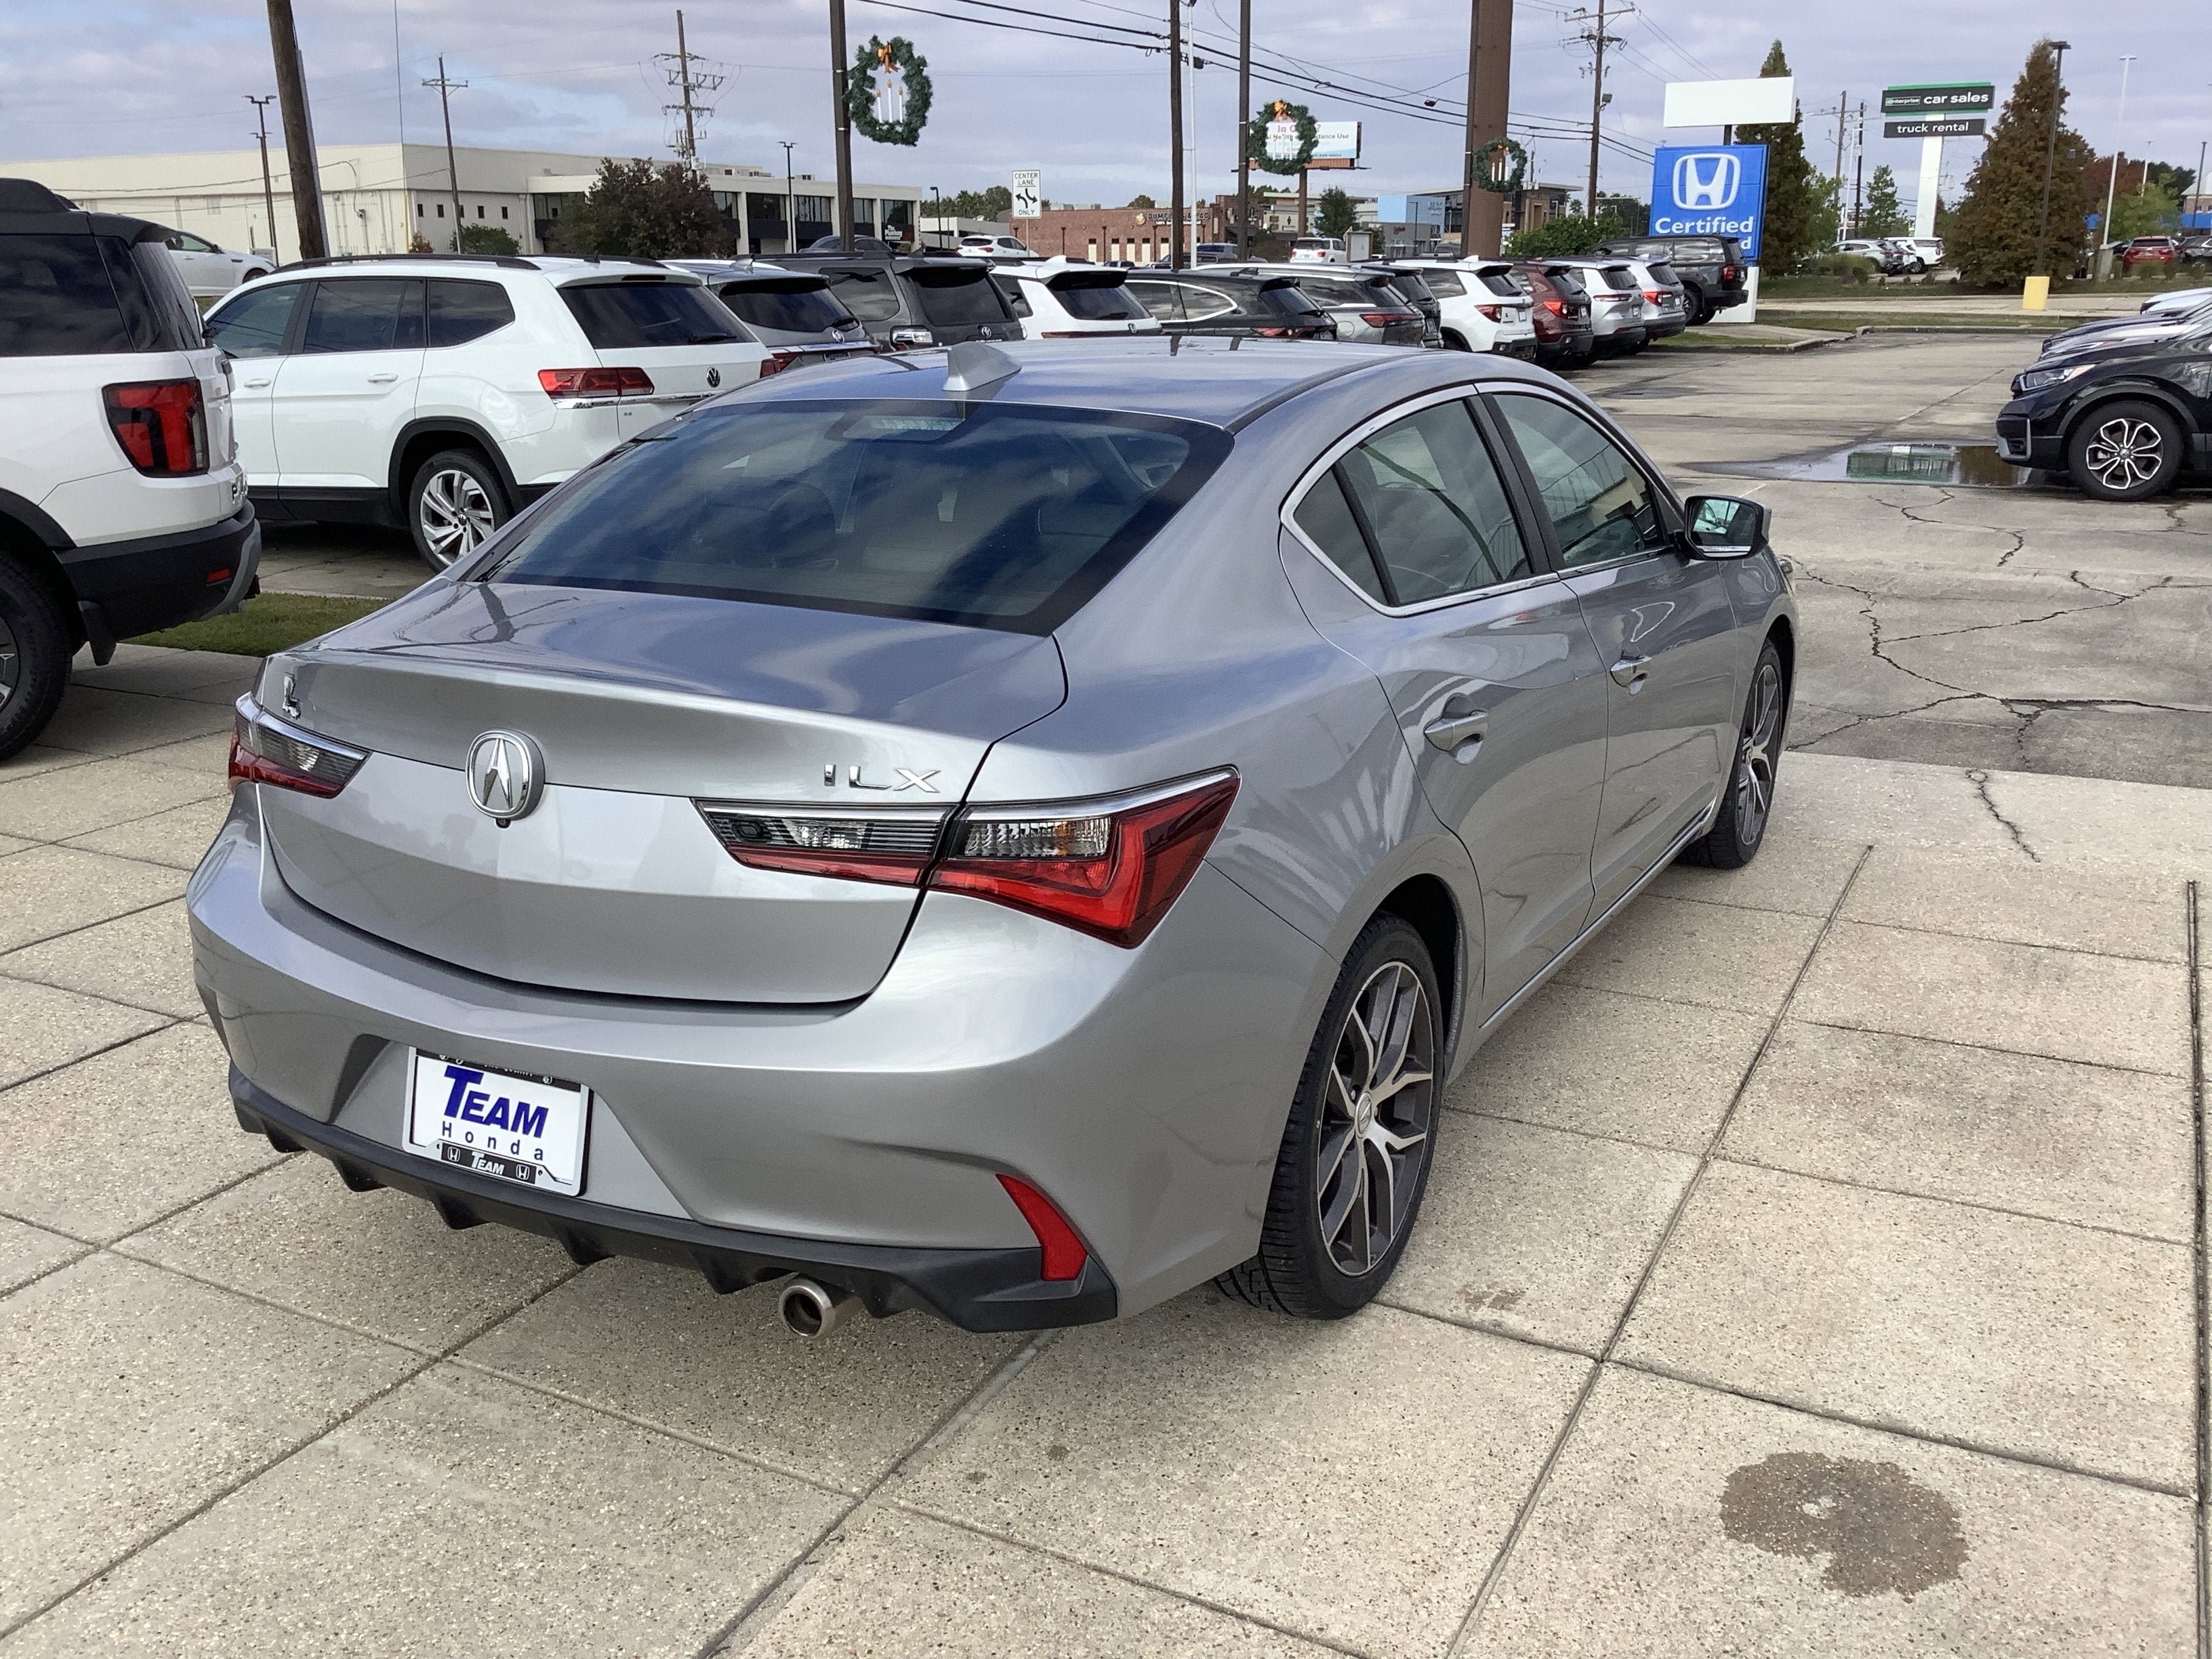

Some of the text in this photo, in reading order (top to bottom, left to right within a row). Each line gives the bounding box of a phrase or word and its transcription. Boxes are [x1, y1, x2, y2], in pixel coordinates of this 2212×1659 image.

[1924, 96, 1948, 104] car
[1950, 91, 1988, 103] sales
[1897, 122, 1969, 133] truck rental
[1195, 211, 1210, 221] AO
[1655, 216, 1754, 234] Certified
[824, 764, 941, 793] ILX
[444, 1065, 549, 1139] TEAM
[443, 1121, 544, 1161] Honda
[471, 1151, 505, 1175] TEAM
